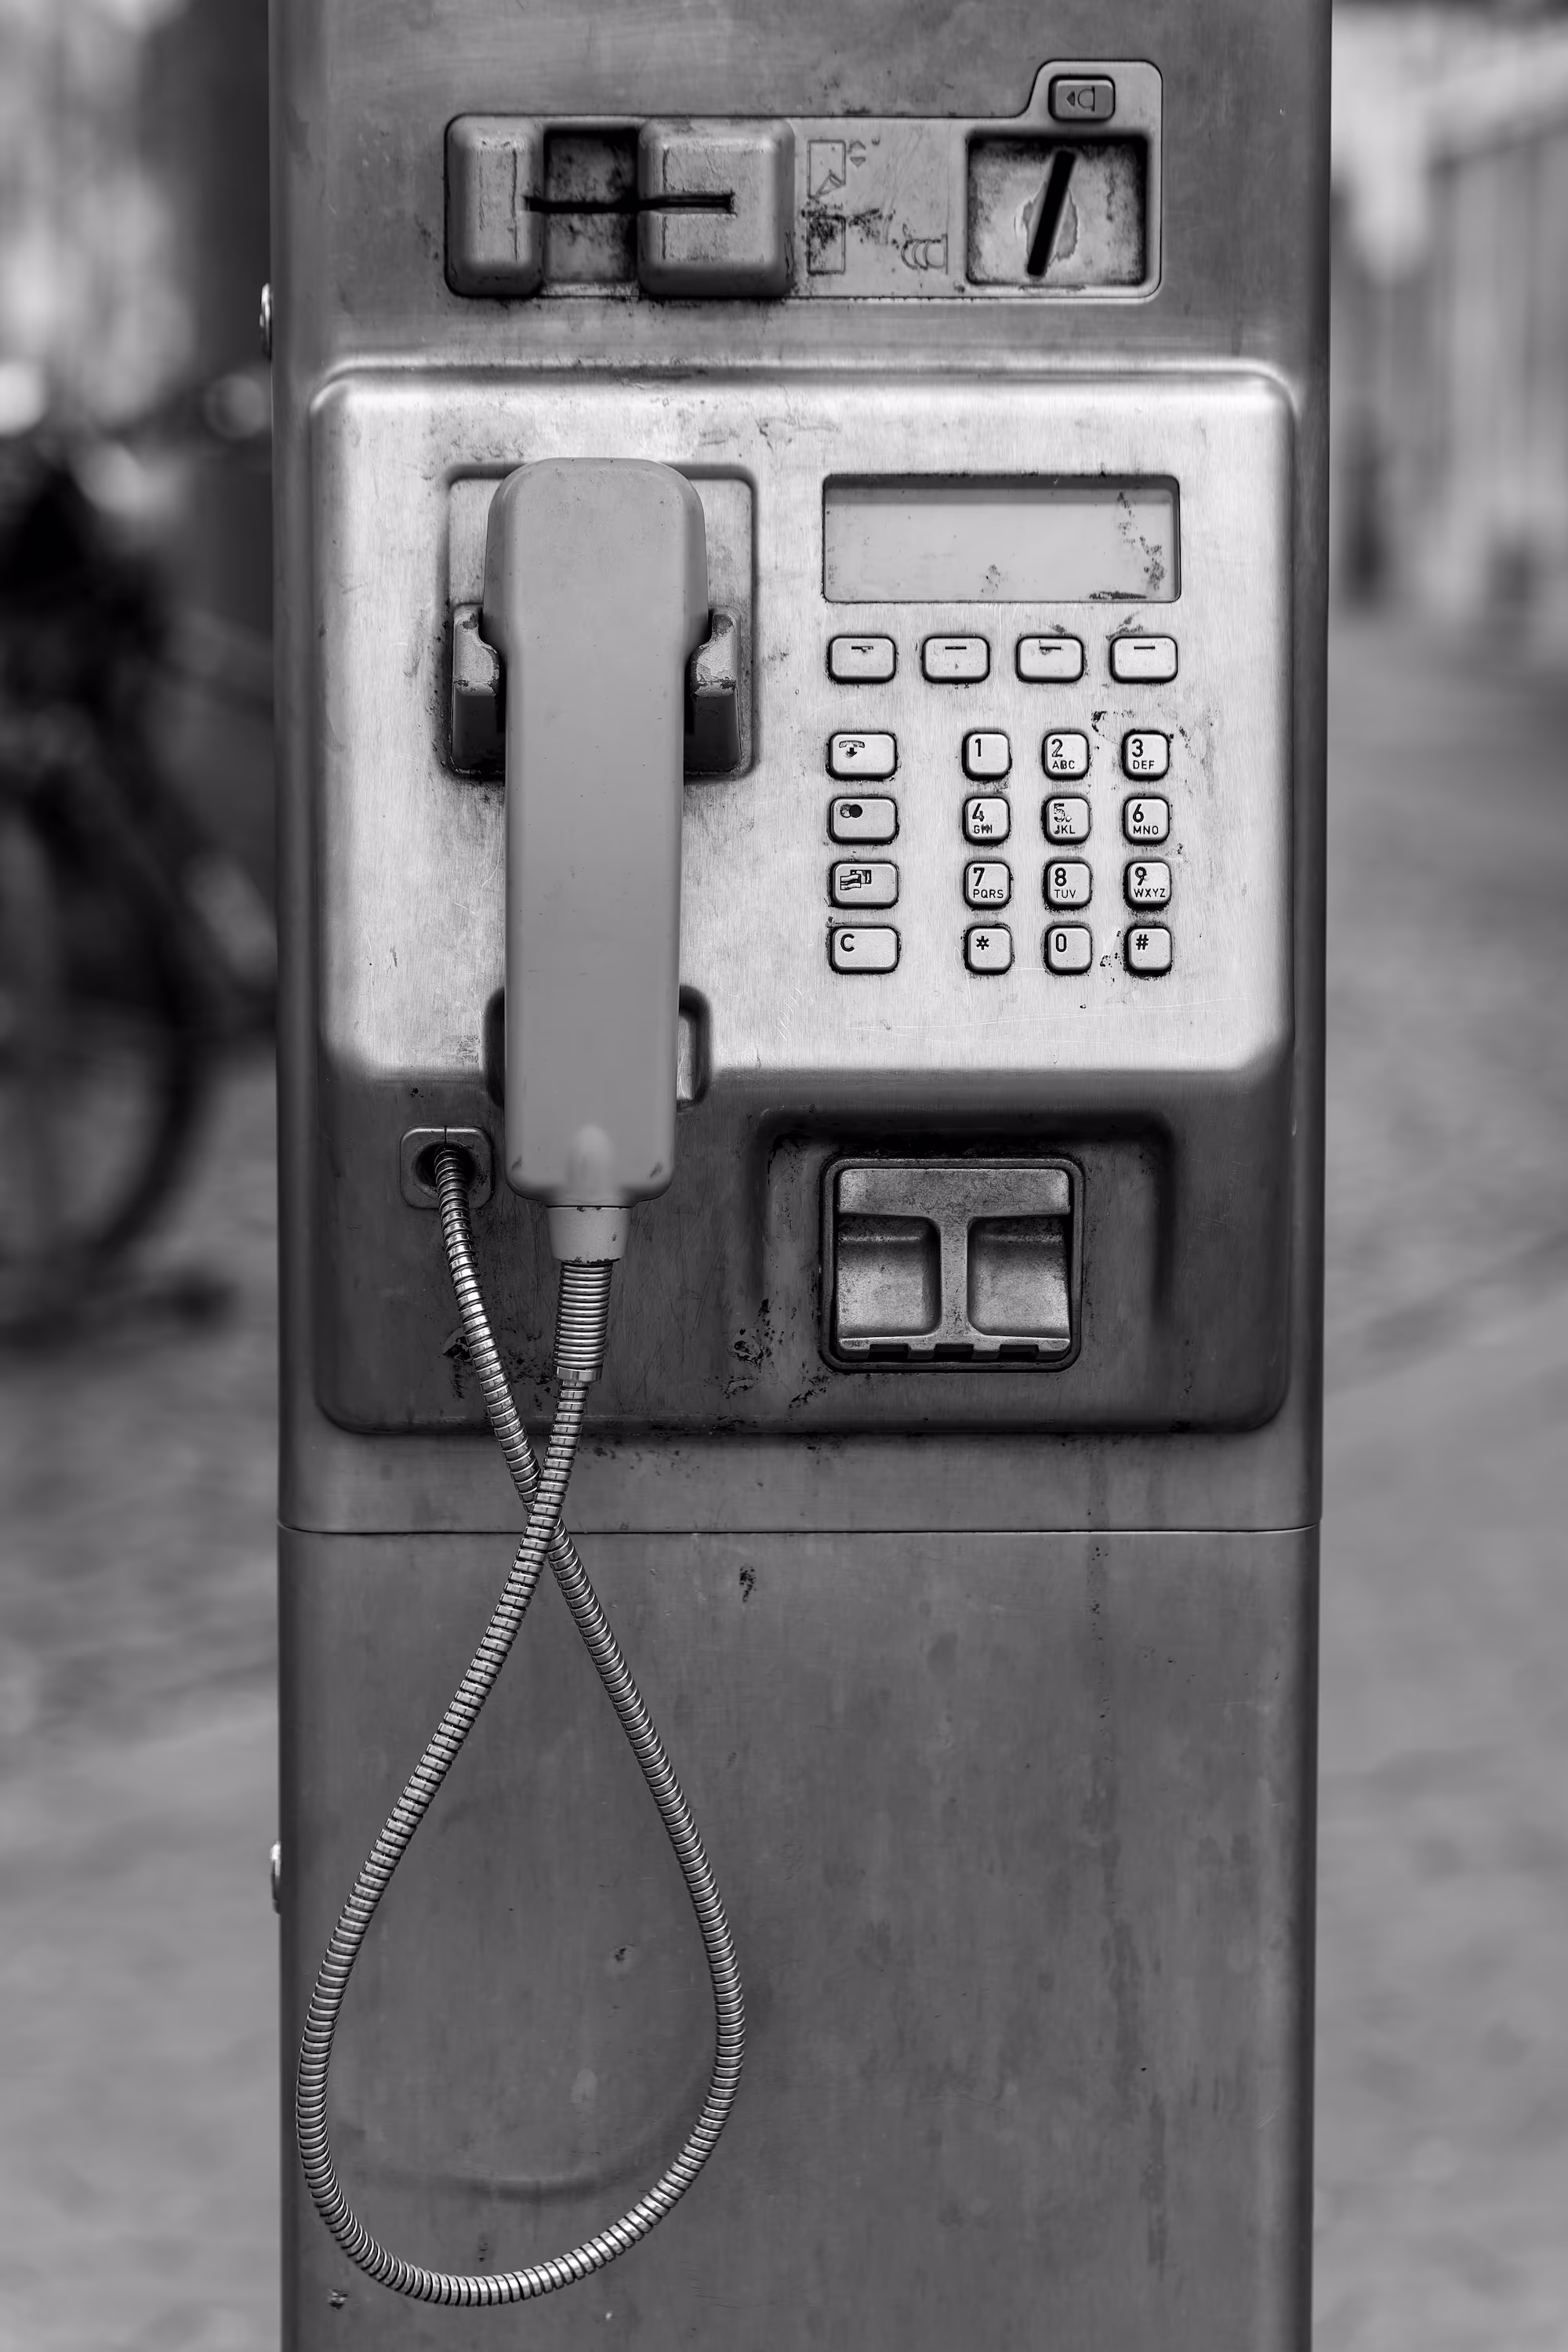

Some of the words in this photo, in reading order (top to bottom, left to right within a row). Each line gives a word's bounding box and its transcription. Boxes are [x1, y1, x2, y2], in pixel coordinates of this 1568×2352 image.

[975, 739, 982, 757] 1
[1051, 739, 1063, 757] 2
[1131, 739, 1144, 757] 3
[1052, 760, 1075, 770] ABC
[1133, 760, 1155, 770] DEF
[972, 804, 984, 822] 4
[1054, 804, 1065, 822] 5
[1132, 803, 1144, 822] 6
[1054, 825, 1076, 834] JKL
[1133, 826, 1159, 835] MNO
[973, 868, 985, 886] 7
[1054, 868, 1066, 887] 8
[1135, 867, 1147, 886] 9
[973, 889, 1004, 898] PQRS
[1054, 889, 1076, 898] TUV
[1134, 888, 1166, 898] WXYZ
[840, 934, 855, 952] C
[1055, 934, 1066, 952] 0
[1136, 934, 1149, 950] #
